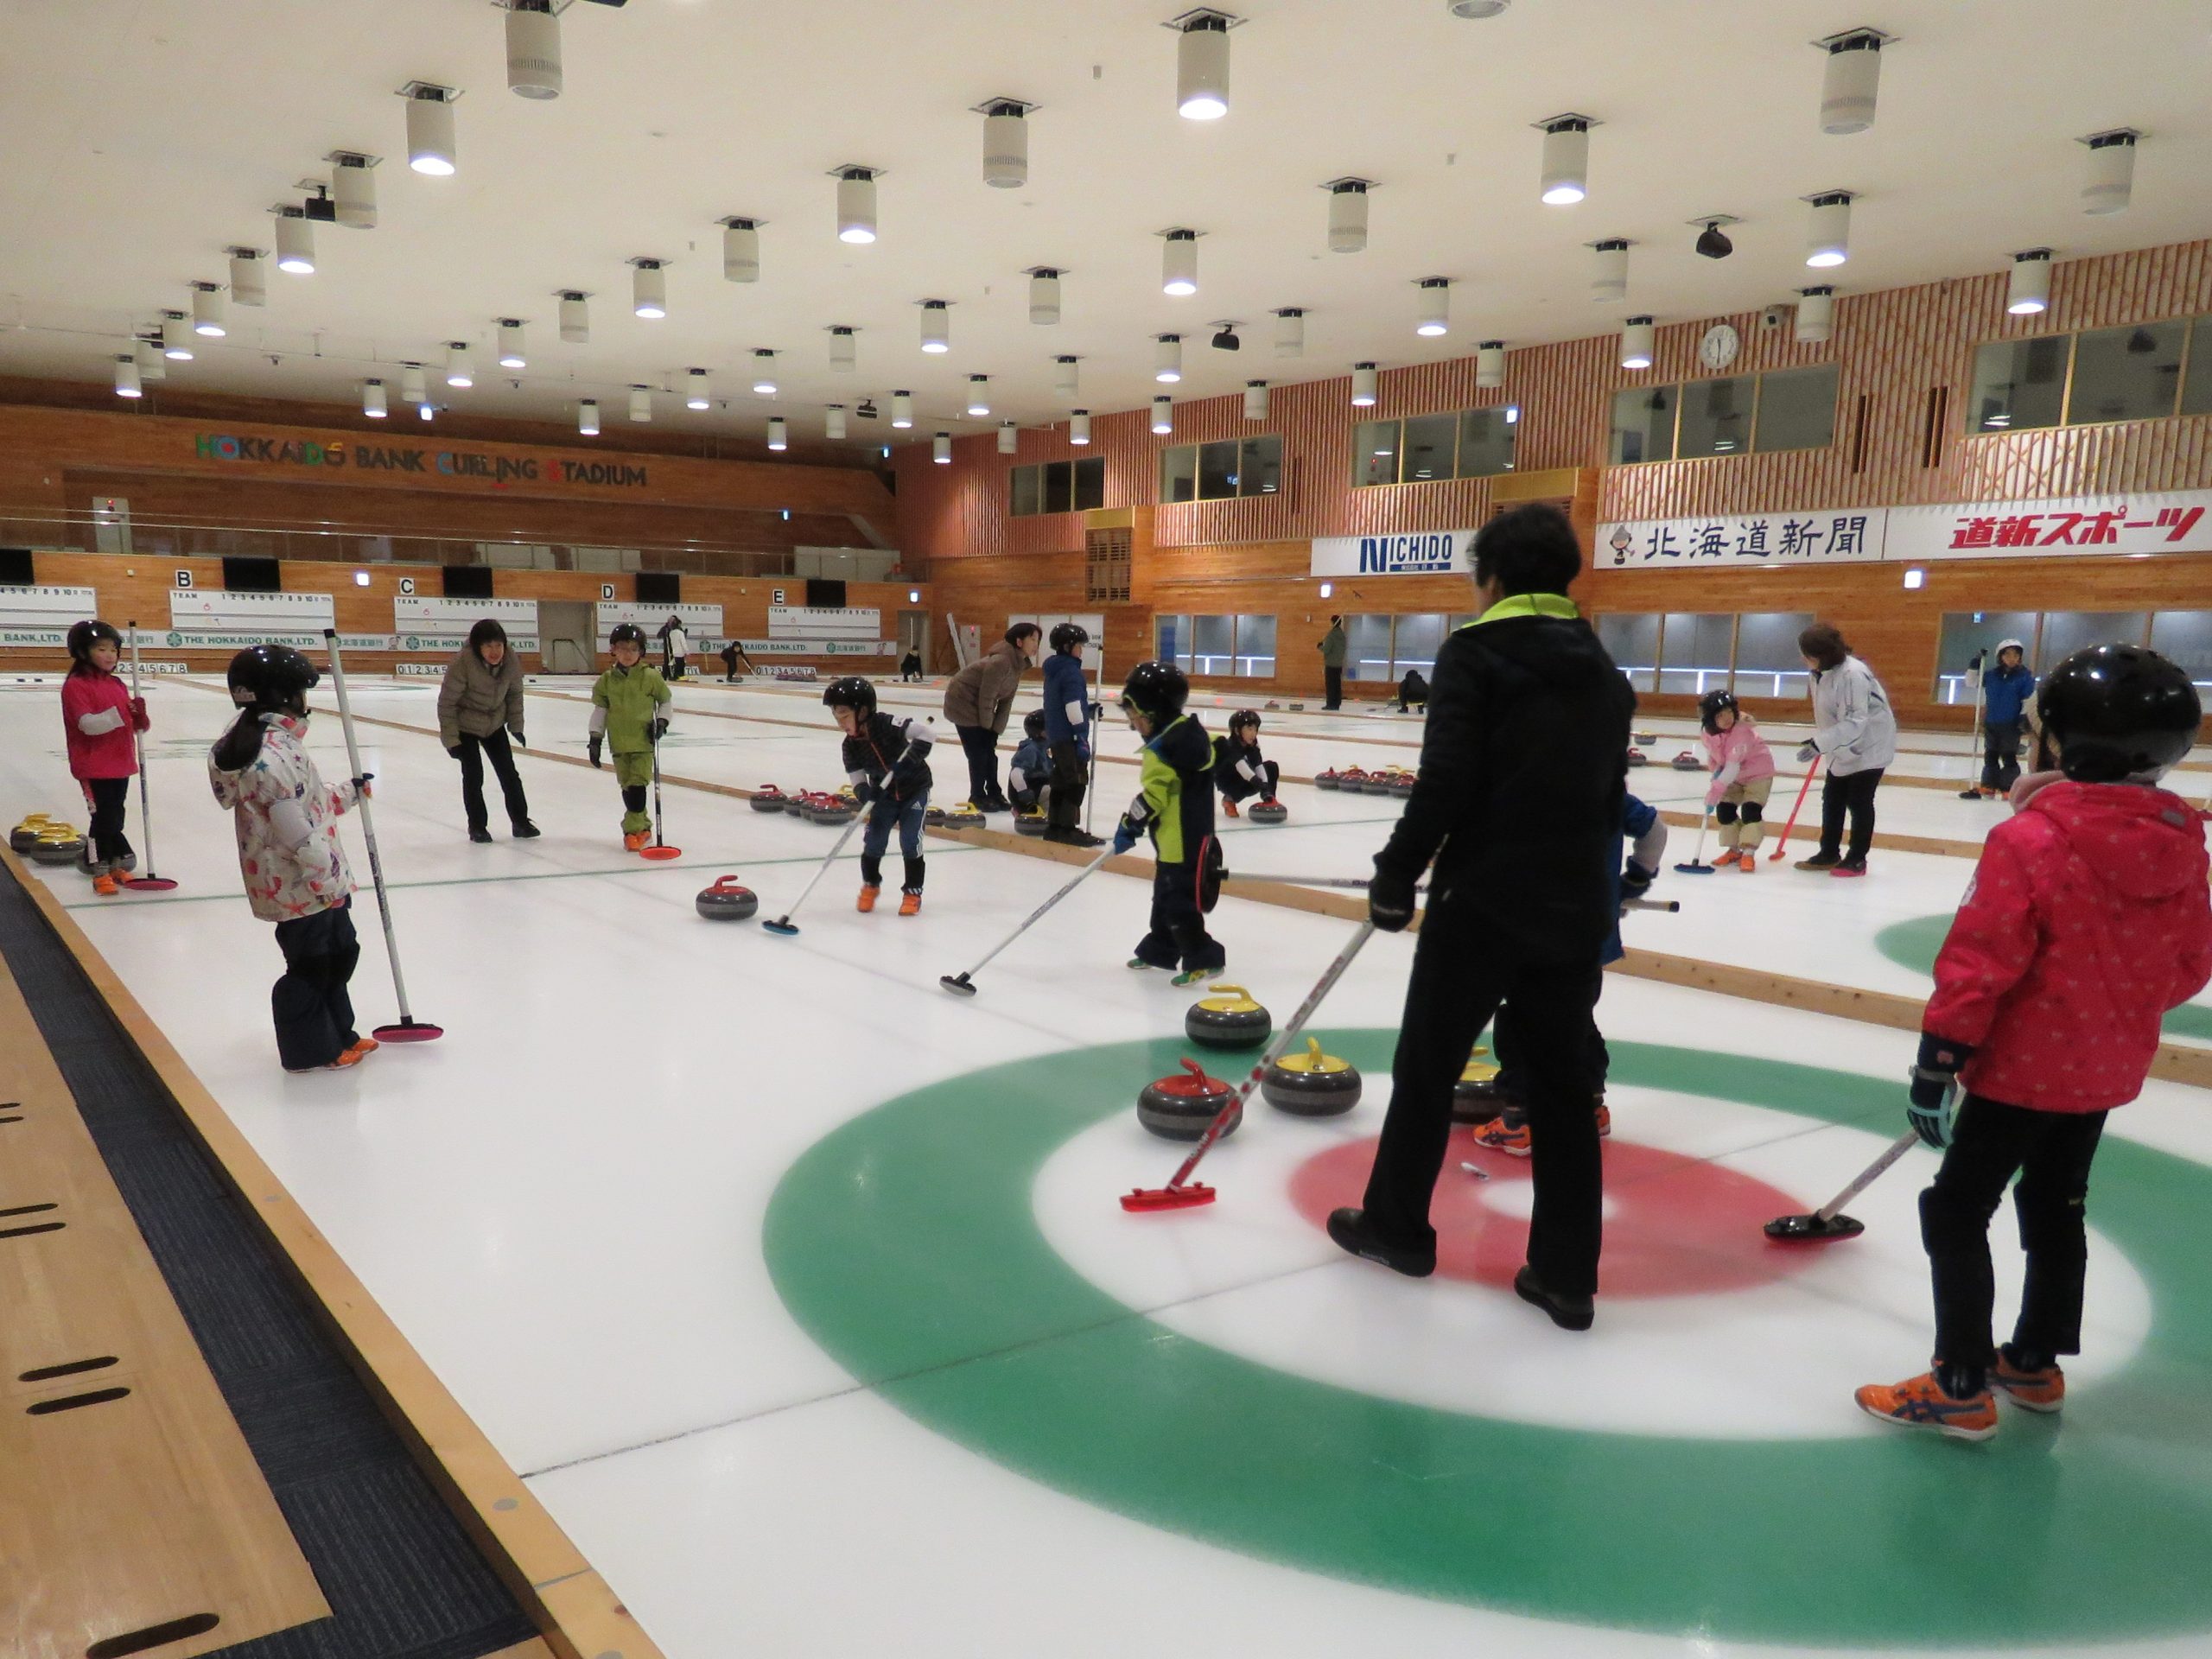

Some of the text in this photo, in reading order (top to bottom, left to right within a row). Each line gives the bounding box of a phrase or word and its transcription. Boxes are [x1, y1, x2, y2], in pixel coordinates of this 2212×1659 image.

[195, 434, 647, 486] HOKKAIDO BANK CURLING STADIUM
[1644, 517, 1867, 560] 北海道新聞
[1948, 505, 2205, 549] 道新スポーツ
[1359, 534, 1452, 573] NICHIDO
[177, 571, 191, 587] B
[401, 579, 413, 594] C
[603, 585, 613, 599] D
[773, 590, 783, 603] E
